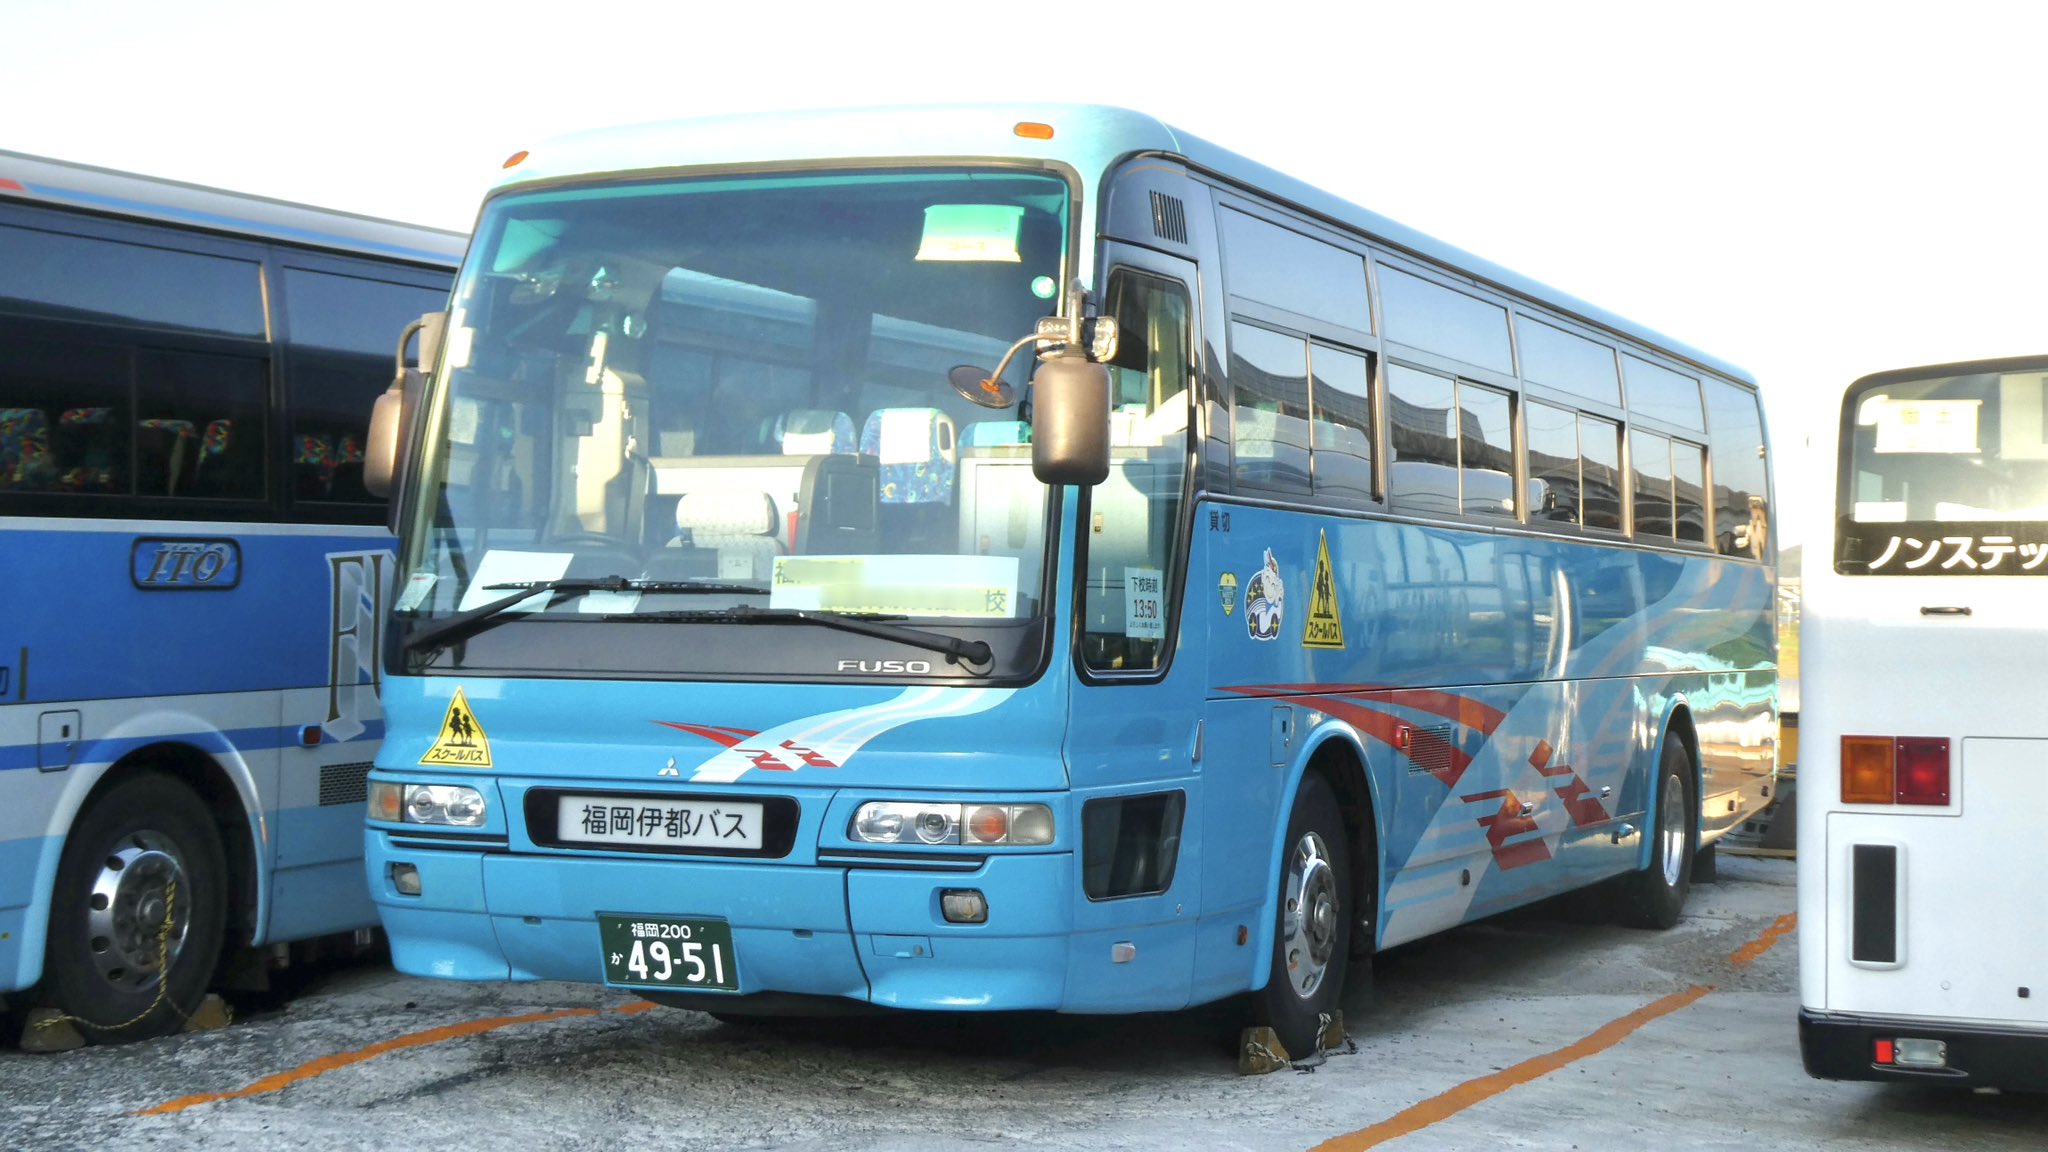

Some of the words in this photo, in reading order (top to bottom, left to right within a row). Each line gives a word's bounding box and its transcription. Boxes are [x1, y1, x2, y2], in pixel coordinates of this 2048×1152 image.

[1210, 510, 1230, 532] 貸切
[143, 543, 231, 582] ITO
[1868, 536, 2048, 570] ノンステッ
[1131, 576, 1158, 593] 下校時刻
[1134, 599, 1158, 619] 13:50
[1308, 621, 1338, 640] スクールバス
[837, 660, 931, 674] FUSO
[431, 748, 484, 761] スクールバス
[581, 804, 747, 839] 福岡伊都バス
[611, 952, 624, 965] か
[628, 940, 724, 984] 49-51
